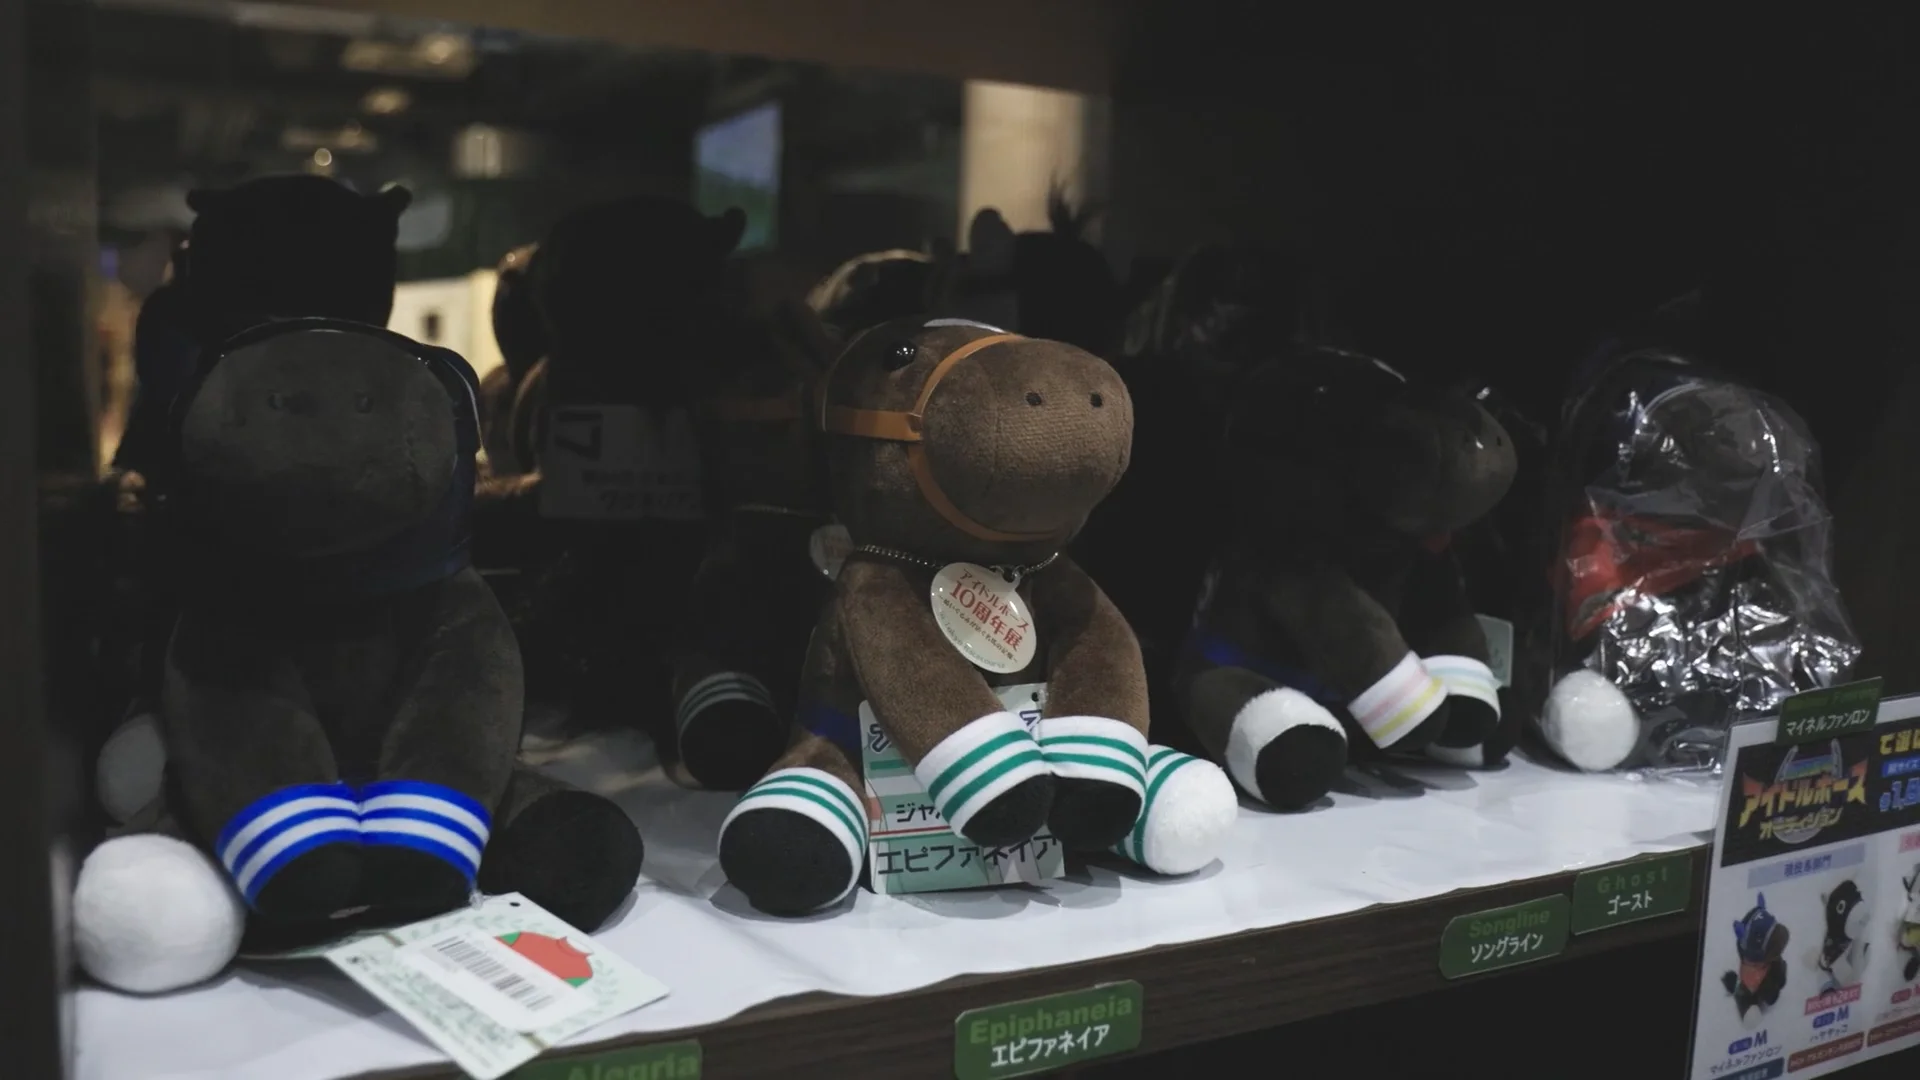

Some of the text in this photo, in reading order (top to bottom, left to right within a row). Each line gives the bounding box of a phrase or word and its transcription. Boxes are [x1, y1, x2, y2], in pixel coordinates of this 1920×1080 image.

[949, 581, 1023, 652] 10周年展
[960, 568, 1030, 633] アイドルホース
[1786, 709, 1870, 736] マイネルファンロン
[1738, 757, 1868, 829] アイドルホース
[1597, 866, 1668, 894] Ghost
[1607, 890, 1653, 916] ゴースト
[1468, 907, 1550, 939] Songline
[1471, 933, 1544, 964] ソングライン
[970, 995, 1132, 1045] Epiphaneia
[991, 1023, 1111, 1068] エピファネイア
